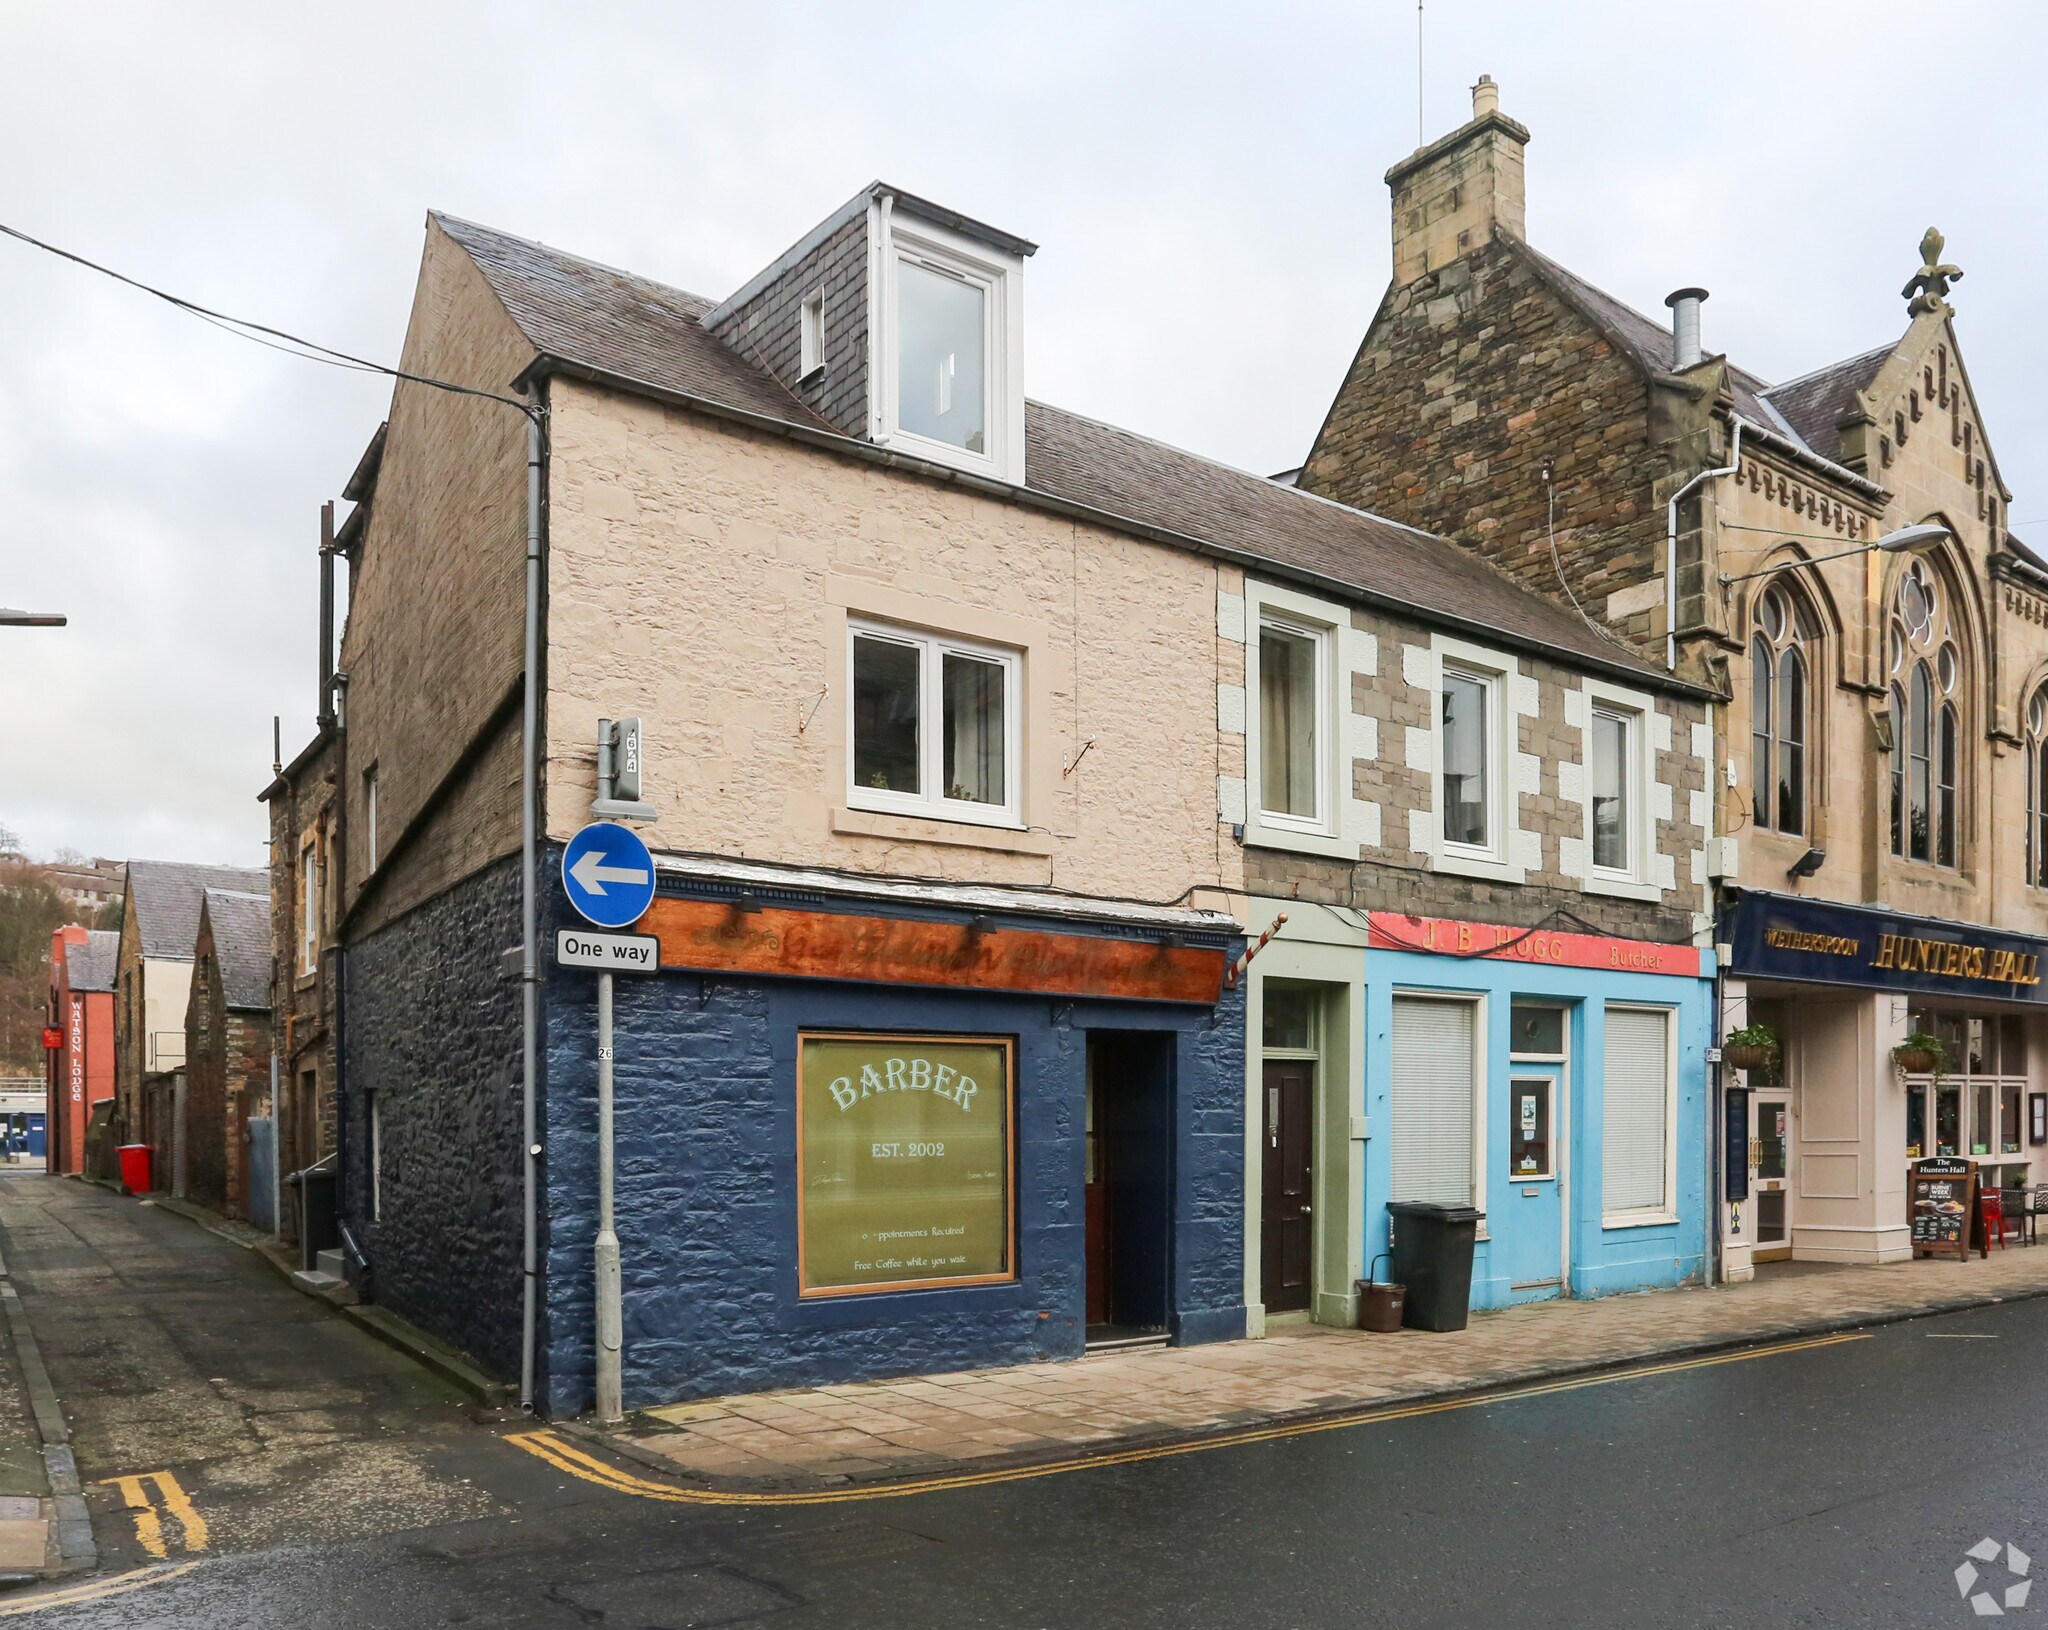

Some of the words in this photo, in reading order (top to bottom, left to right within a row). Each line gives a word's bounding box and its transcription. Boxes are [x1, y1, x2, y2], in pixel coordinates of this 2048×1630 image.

[565, 938, 603, 957] One
[612, 946, 650, 963] way
[1495, 929, 1563, 961] HOGG
[1764, 928, 1859, 956] WETHERSPOON
[1610, 946, 1662, 969] Butcher
[1869, 933, 1986, 979] HUNTERS
[1987, 950, 2041, 985] HALL
[71, 1002, 82, 1053] WATSON
[599, 1048, 612, 1059] 26
[71, 1058, 82, 1102] LODGE
[828, 1058, 979, 1113] BARBER
[872, 1143, 904, 1158] EST.
[908, 1142, 945, 1157] 2002
[873, 1229, 928, 1242] ppointments
[854, 1260, 872, 1271] Free
[875, 1258, 902, 1270] Coffee
[906, 1256, 928, 1267] while
[931, 1258, 946, 1268] you
